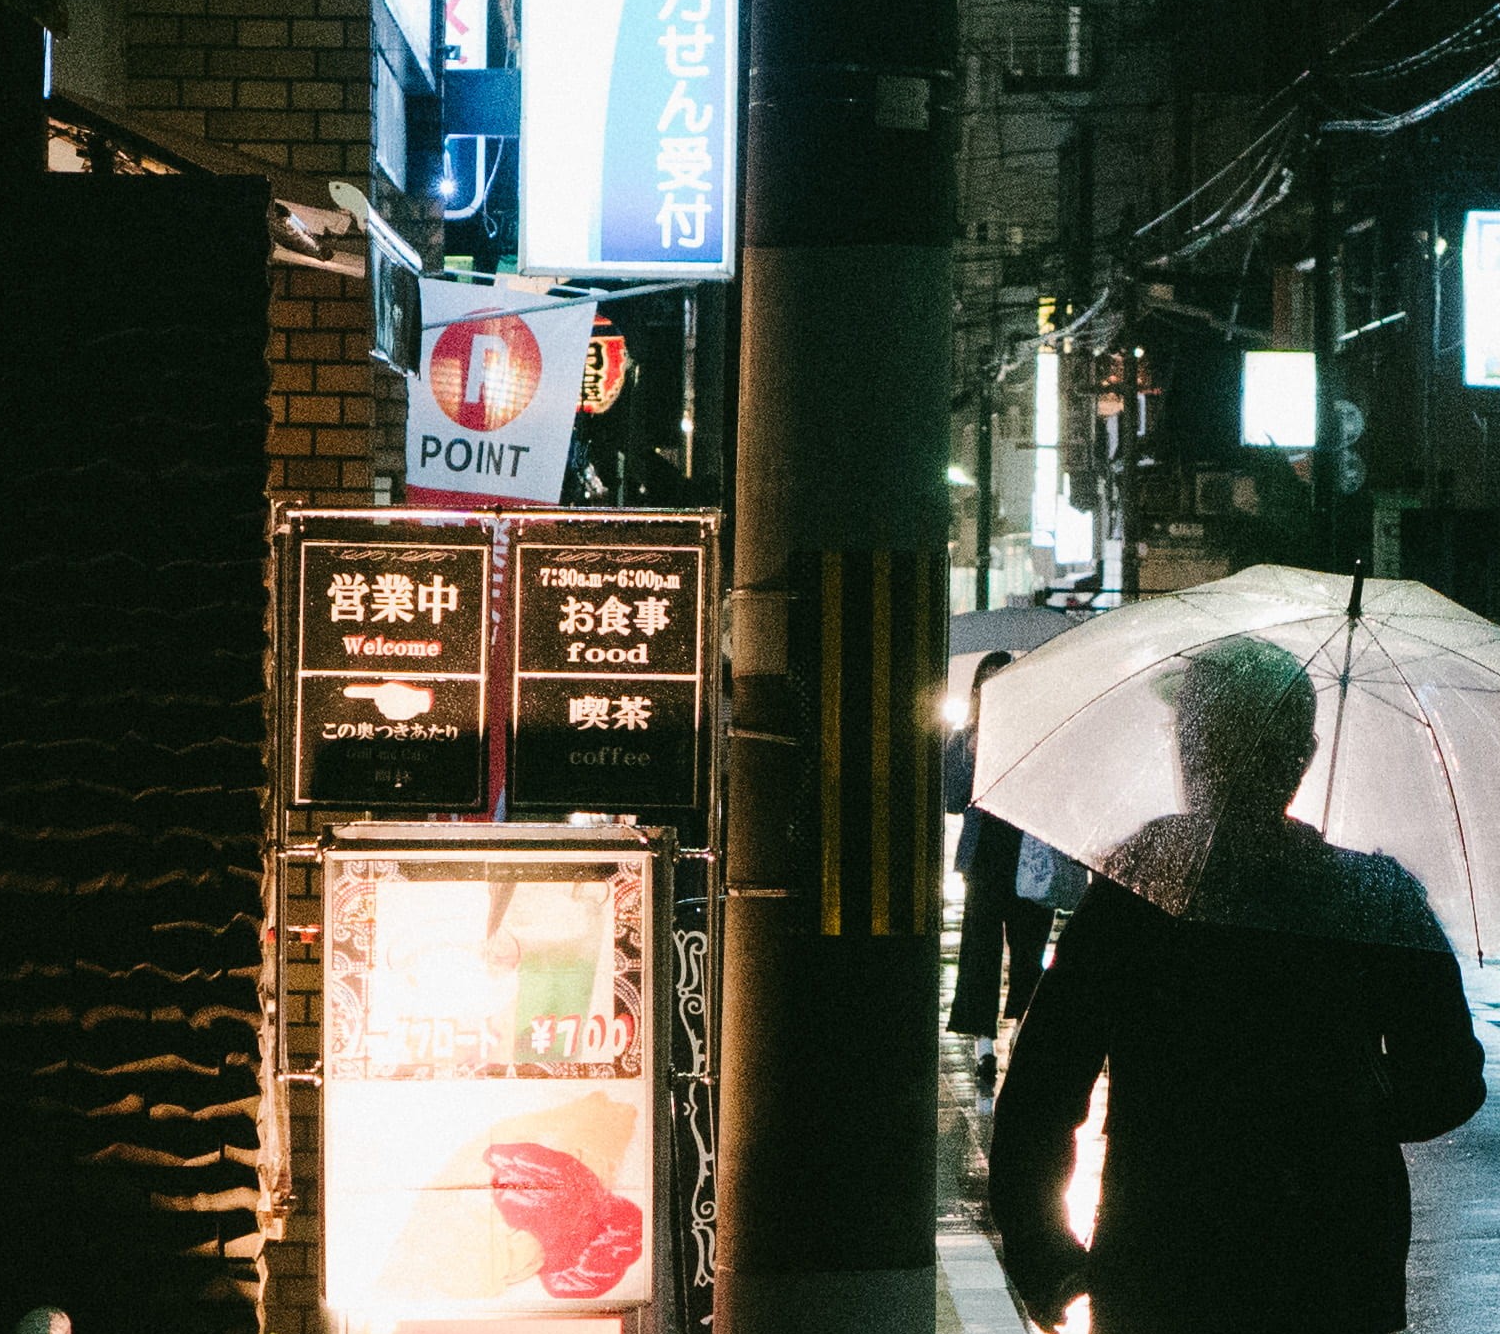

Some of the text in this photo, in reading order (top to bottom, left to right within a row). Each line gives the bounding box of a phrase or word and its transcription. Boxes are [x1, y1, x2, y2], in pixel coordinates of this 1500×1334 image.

[420, 435, 531, 479] POINT
[326, 572, 459, 624] 営業中
[558, 595, 671, 636] お食事
[342, 635, 443, 658] Welcome
[566, 643, 650, 664] food
[322, 722, 458, 741] この奥つきあたり
[569, 695, 652, 732] 喫茶
[568, 749, 651, 767] coffee
[529, 1012, 634, 1058] ¥700
